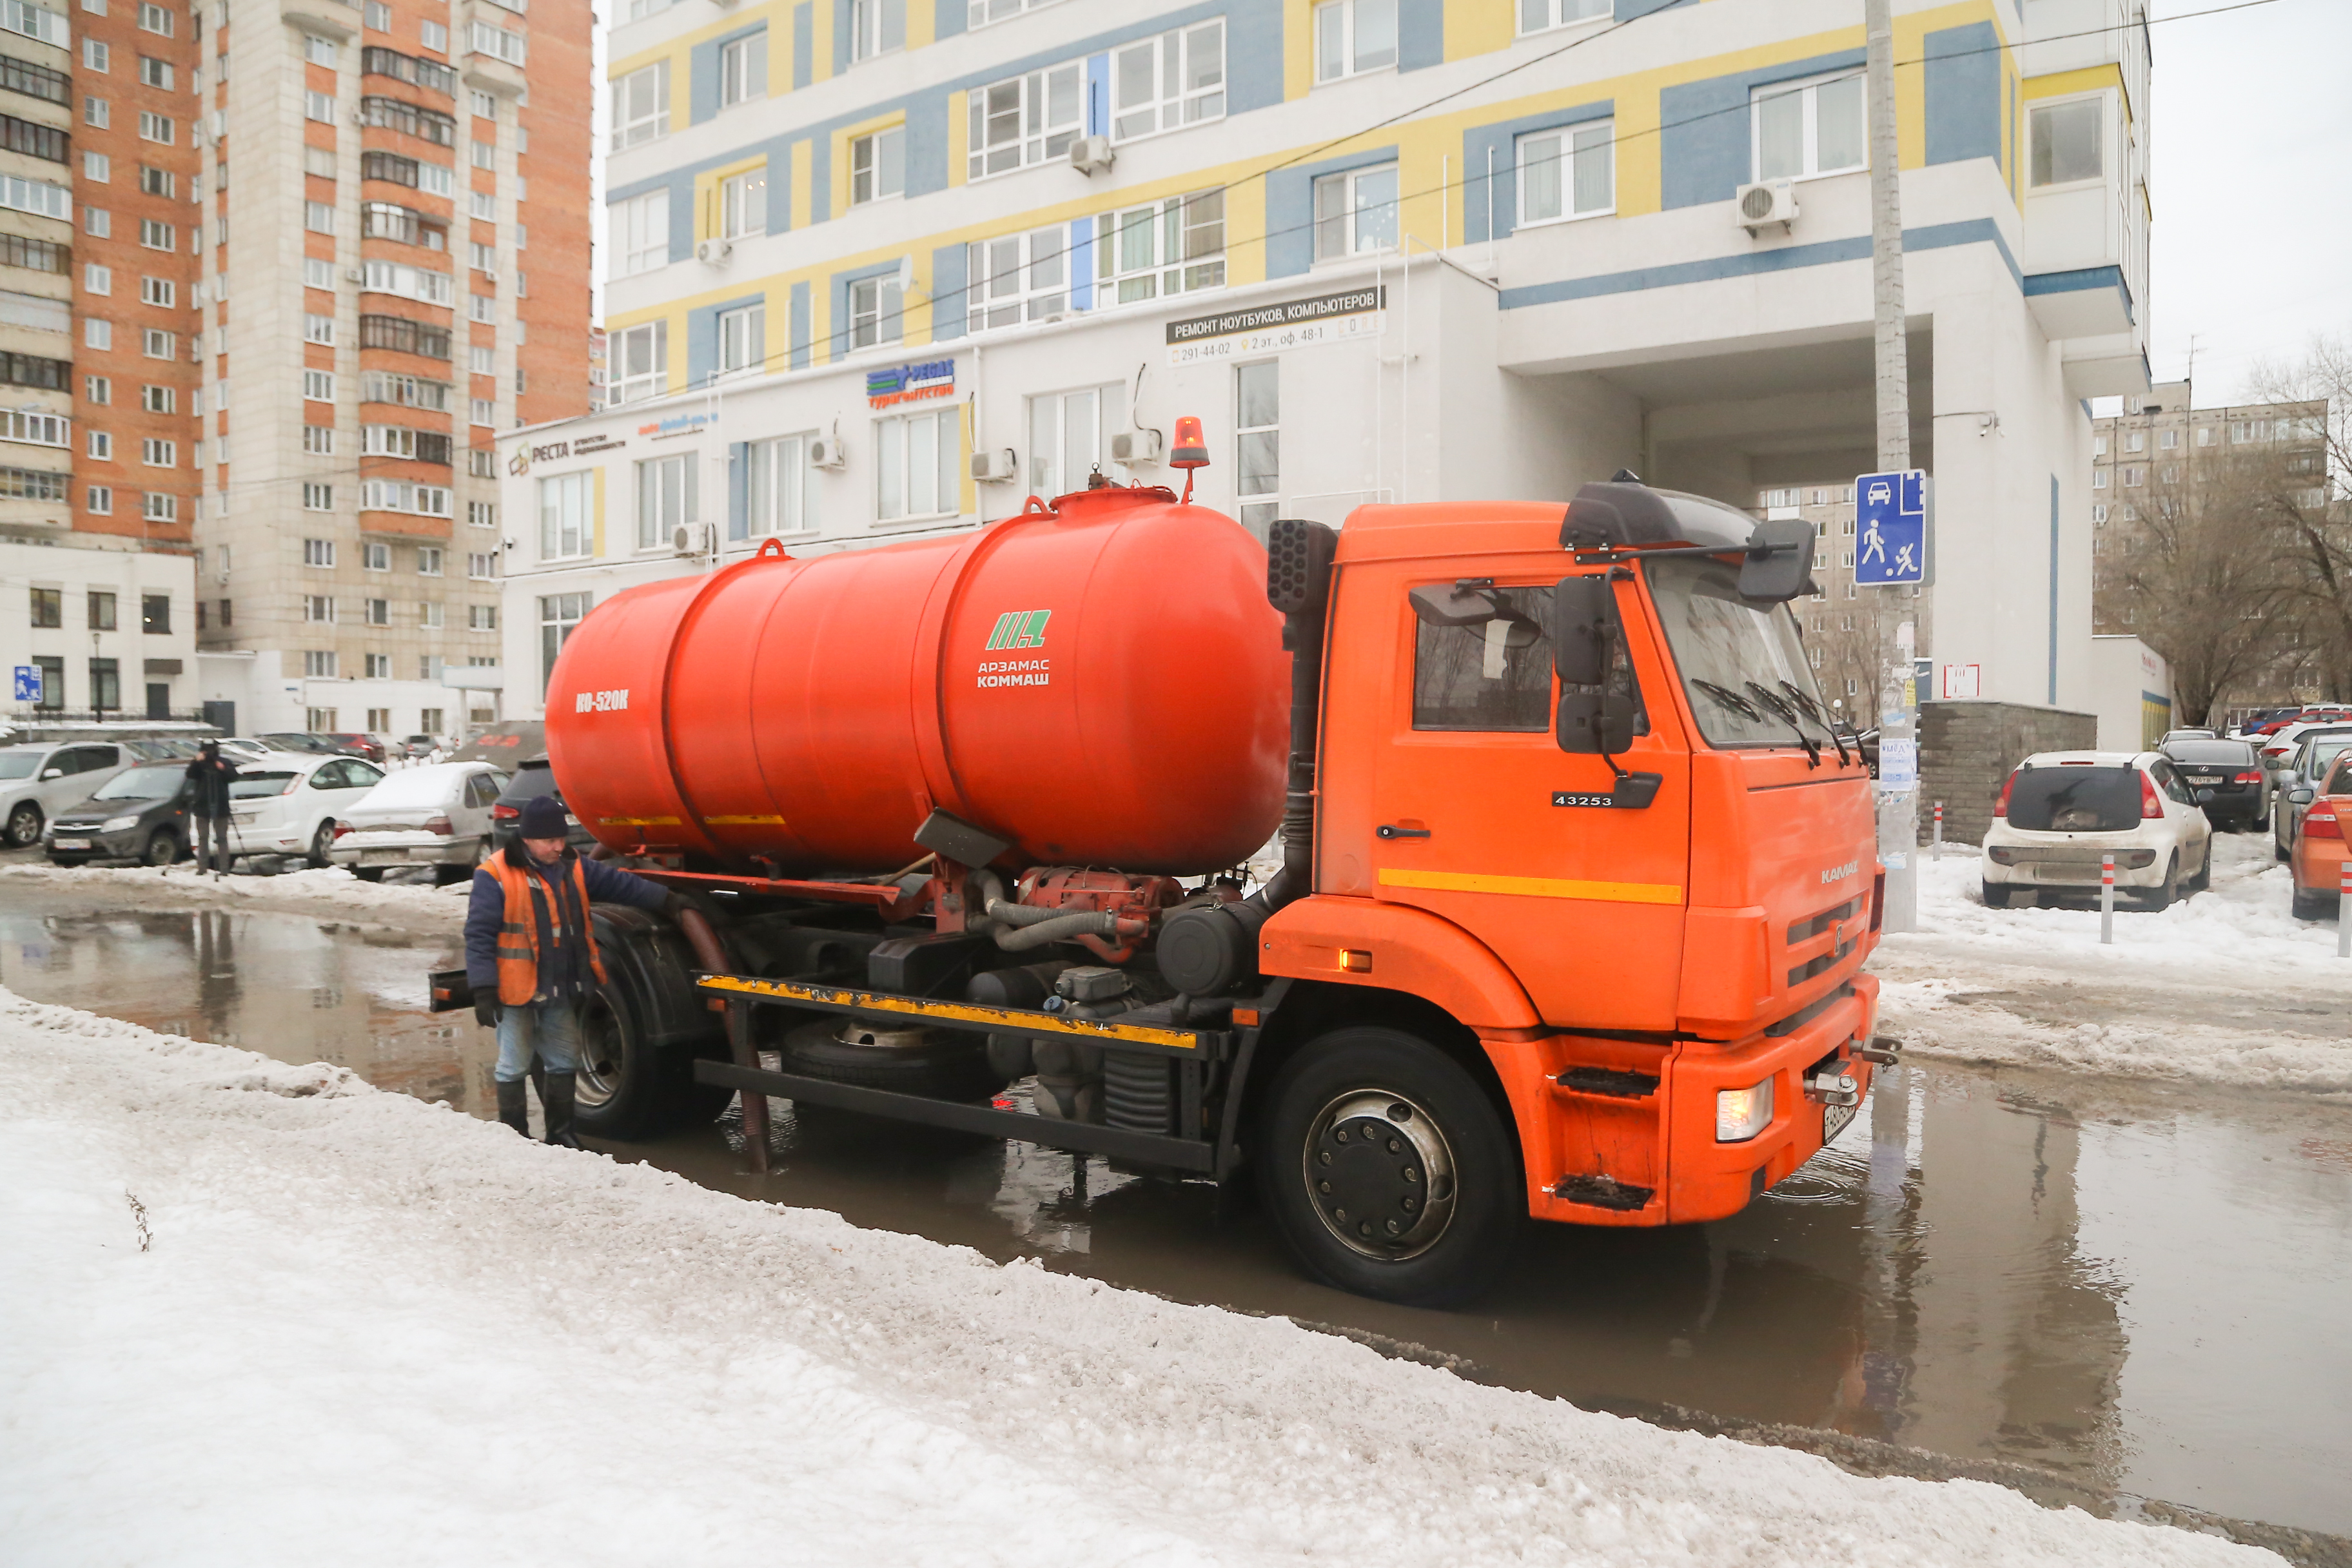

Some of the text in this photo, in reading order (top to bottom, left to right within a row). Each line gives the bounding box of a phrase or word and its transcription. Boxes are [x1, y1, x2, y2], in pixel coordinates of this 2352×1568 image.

[1175, 292, 1375, 338] РЕМОНТ НОУТБУКОВ, КОМПЬЮТЕРОВ
[1182, 342, 1230, 361] 291-44-02
[1252, 338, 1258, 349] 2
[1280, 331, 1297, 346] оф.
[1301, 327, 1323, 341] 48-1
[912, 359, 954, 381] PEGAS
[533, 442, 569, 463] РЕСТА
[978, 659, 1050, 673] АРЗАМАС
[977, 673, 1050, 688] КОММАШ
[576, 689, 630, 713] КО-520К
[1555, 796, 1612, 806] 43253
[1821, 859, 1858, 884] KAMAZ
